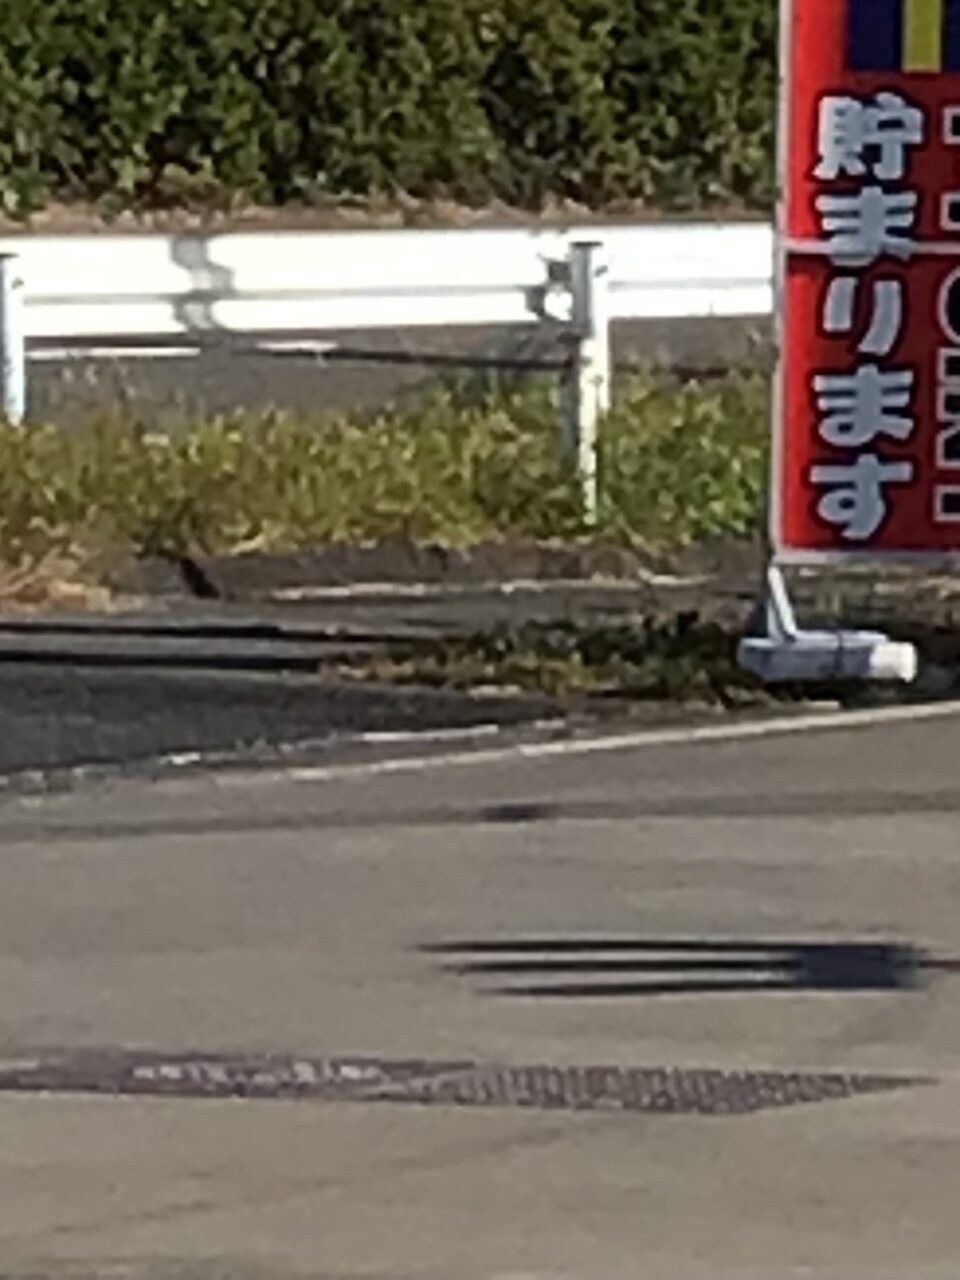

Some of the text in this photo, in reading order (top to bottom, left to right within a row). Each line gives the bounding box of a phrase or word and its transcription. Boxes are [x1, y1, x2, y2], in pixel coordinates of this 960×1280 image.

[810, 92, 923, 540] 貯まります
